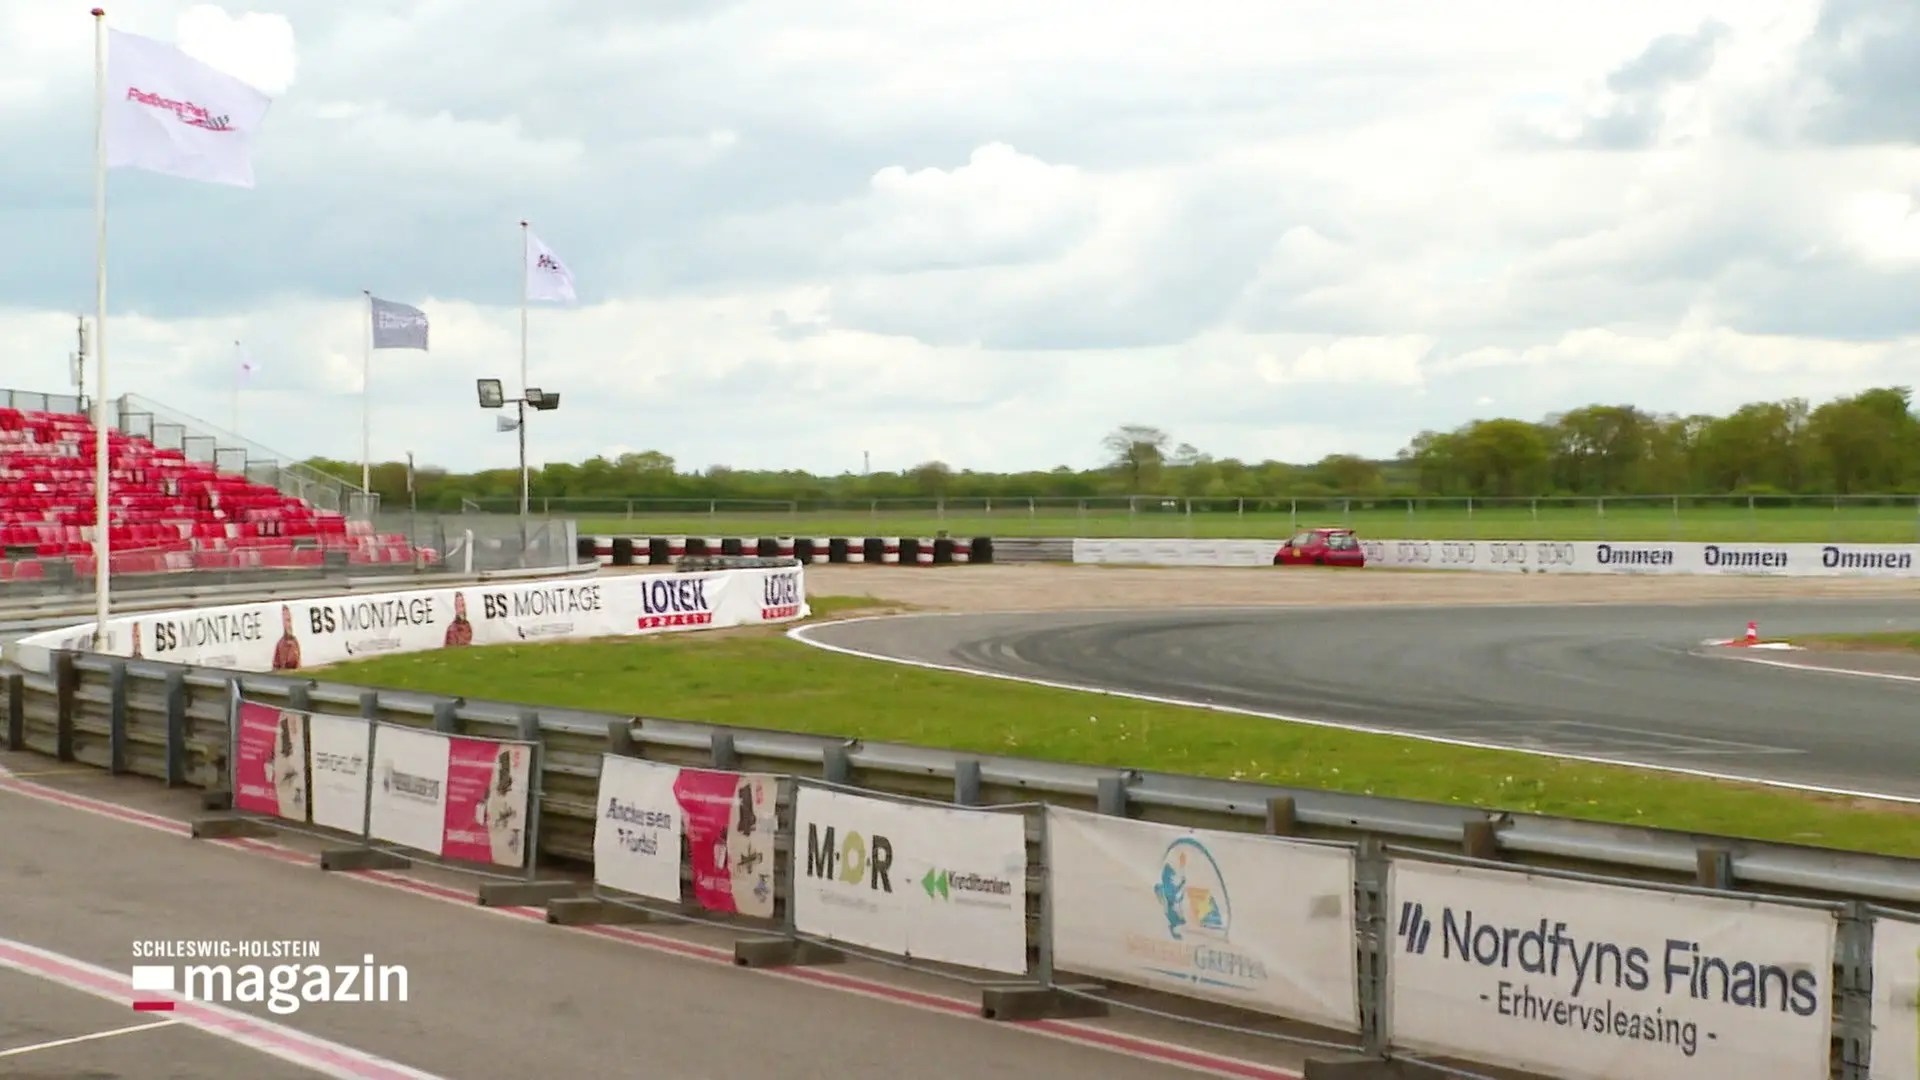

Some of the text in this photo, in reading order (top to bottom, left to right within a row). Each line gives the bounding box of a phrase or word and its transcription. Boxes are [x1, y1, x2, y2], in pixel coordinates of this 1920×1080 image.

[309, 598, 435, 634] BS MONTAGE
[483, 585, 601, 620] BS MONTAGE
[155, 621, 177, 652] BS
[180, 612, 262, 648] MONTAGE
[1443, 907, 1817, 1016] Nordfyns Finans
[1498, 981, 1697, 1056] Erhvervsleasing
